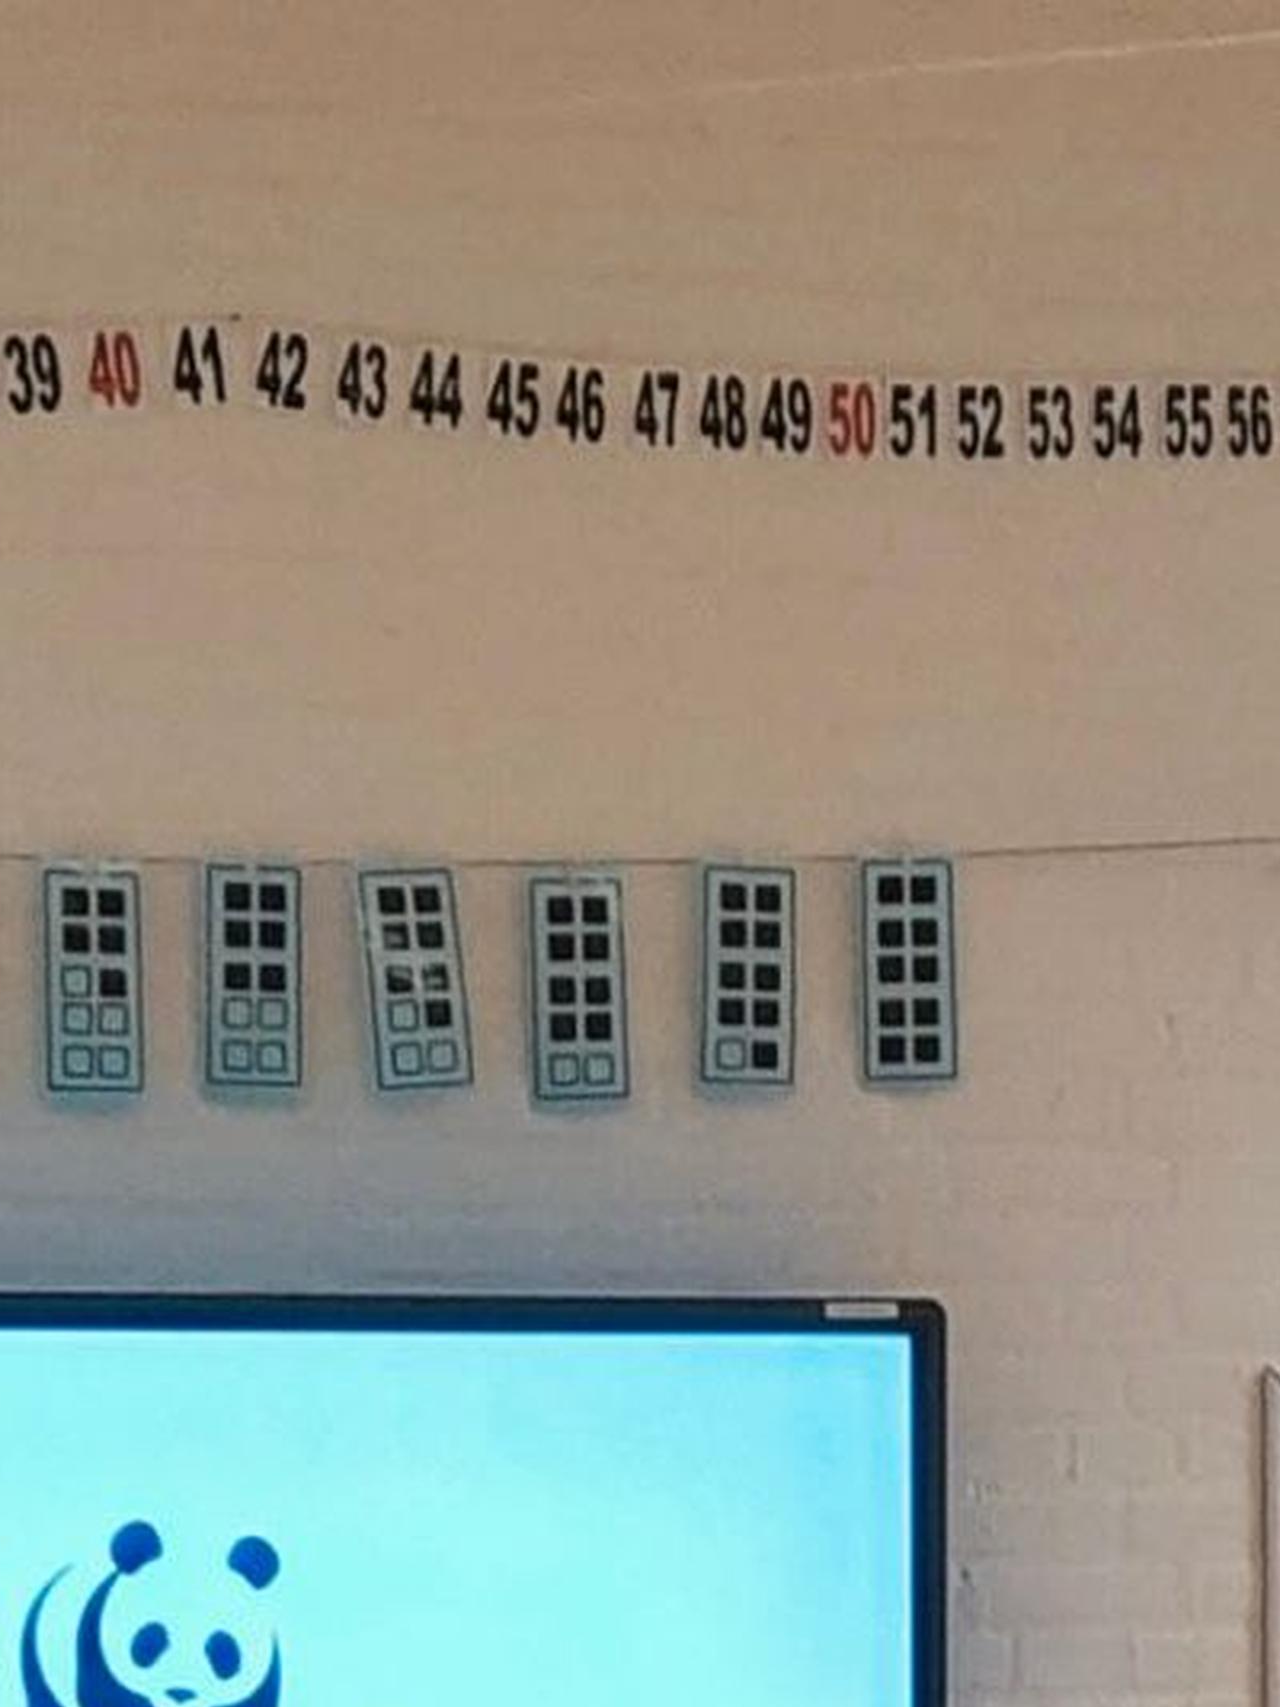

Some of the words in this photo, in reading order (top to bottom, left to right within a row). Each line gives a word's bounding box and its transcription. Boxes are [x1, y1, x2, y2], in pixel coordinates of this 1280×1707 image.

[2, 332, 63, 416] 39
[87, 330, 142, 408] 40
[172, 325, 228, 406] 41
[254, 330, 309, 412] 42
[336, 340, 388, 421] 43
[407, 348, 464, 430] 44
[485, 359, 541, 440] 45
[554, 365, 607, 444] 46
[633, 370, 681, 449] 47
[698, 373, 749, 451] 48
[758, 377, 814, 456] 49
[828, 381, 877, 458] 50
[889, 383, 938, 459] 51
[957, 383, 1006, 461] 52
[1027, 384, 1076, 461] 53
[1092, 384, 1144, 461] 54
[1164, 383, 1214, 459] 55
[1226, 384, 1274, 459] 56
